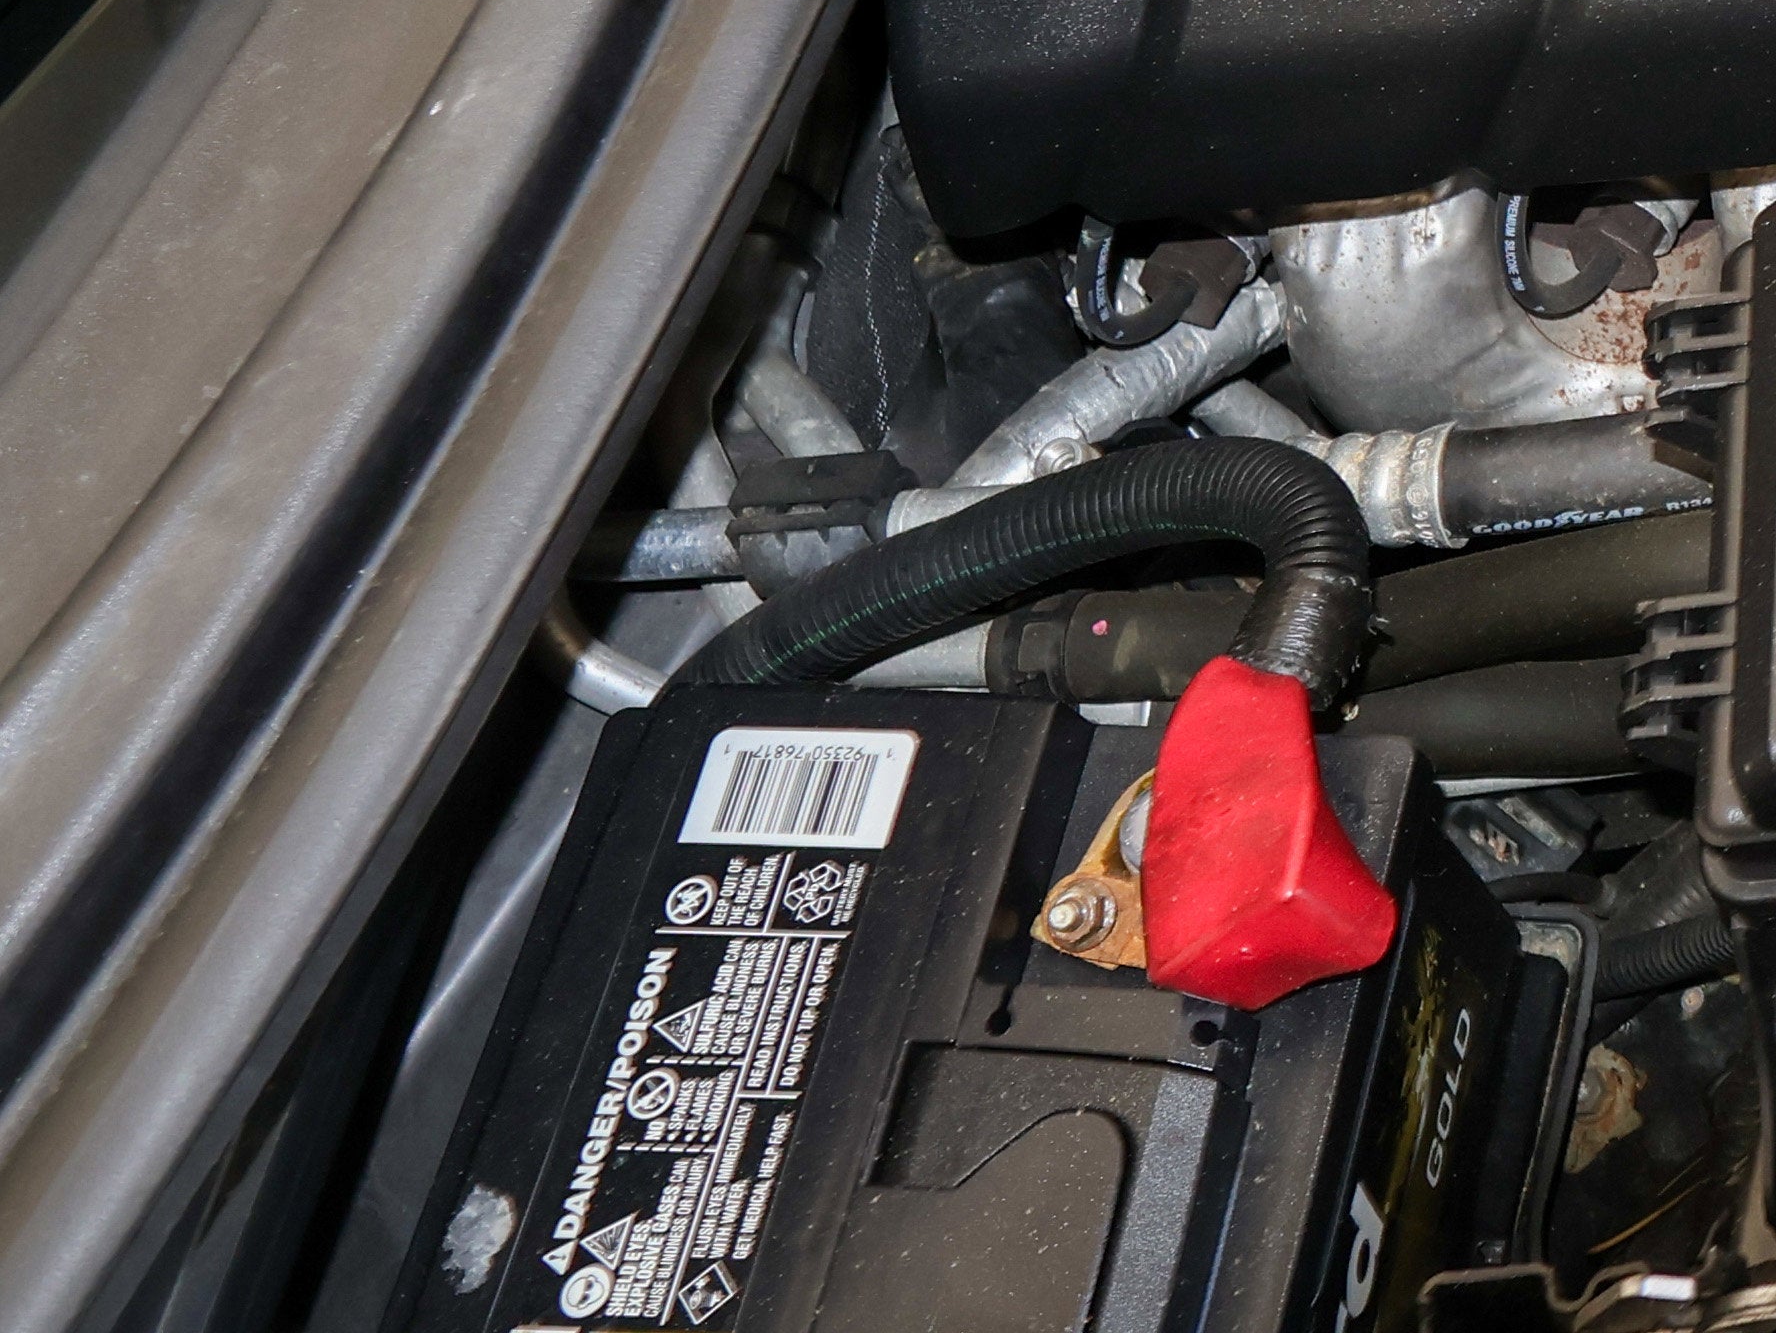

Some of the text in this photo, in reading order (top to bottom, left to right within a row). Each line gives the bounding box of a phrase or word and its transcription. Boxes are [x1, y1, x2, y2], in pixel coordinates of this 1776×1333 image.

[1472, 506, 1645, 534] GOODYEAR
[751, 745, 803, 761] 76817
[811, 744, 864, 762] 92350
[710, 858, 744, 925] KEEP OUT OF
[727, 868, 758, 925] THE REACH
[743, 854, 780, 925] OF CHILDREN.
[804, 883, 819, 899] Pb
[831, 887, 849, 924] BATTERY
[691, 940, 743, 1053] SULFURIC ACID CAN
[711, 942, 759, 1053] CAUSE BLINDNESS
[728, 938, 778, 1054] OR SEVERE BURNS.
[746, 940, 806, 1086] READ INSTRUCTIONS.
[780, 943, 837, 1085] DO NOT TIP OR OPEN.
[552, 950, 671, 1238] DANGER/POISON
[644, 1122, 665, 1140] NO
[668, 1079, 696, 1129] SPARKS
[685, 1080, 714, 1129] FLAMES
[702, 1071, 734, 1130] SMOKING
[1426, 1008, 1470, 1188] GOLD
[691, 1105, 752, 1257] FLUSH EYES IMMEDIATELY
[709, 1179, 747, 1258] WITH WATER.
[732, 1113, 790, 1258] GET MEDICAL HELP FAST.
[605, 1218, 652, 1315] SHIELD EYES.
[624, 1161, 687, 1315] EXPLOSIVE GASES CAN
[644, 1155, 707, 1316] CAUSE BLINDNESS OR INJURY.
